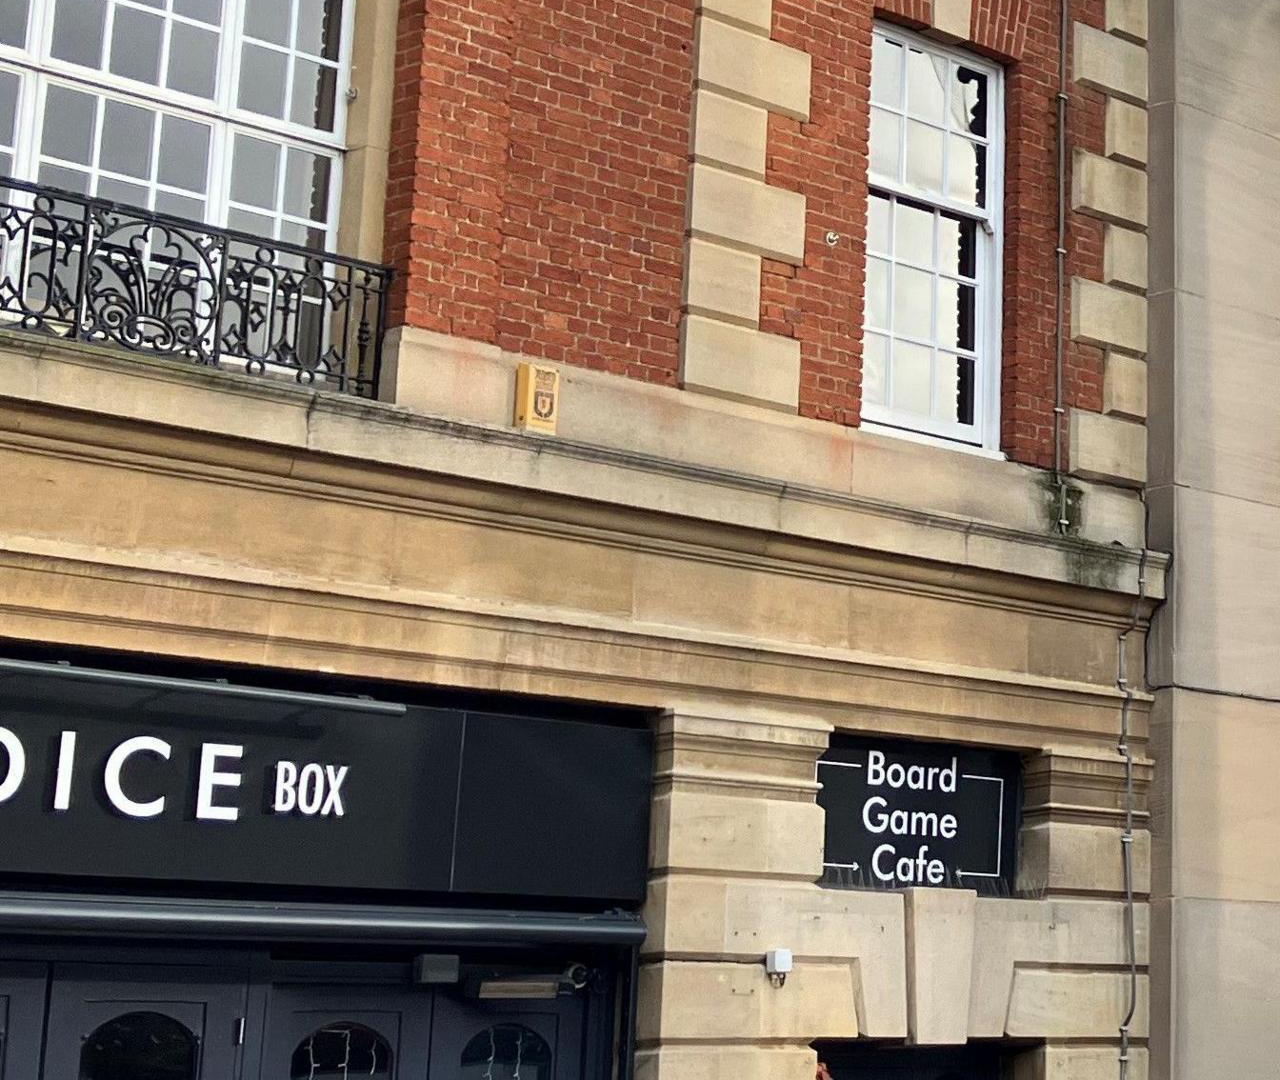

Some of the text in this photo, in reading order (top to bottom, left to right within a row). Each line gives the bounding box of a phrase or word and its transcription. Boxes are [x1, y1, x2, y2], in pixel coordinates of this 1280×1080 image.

[275, 761, 348, 816] BOX
[867, 750, 957, 792] Board
[862, 796, 957, 838] Game
[872, 844, 944, 884] Cafe
